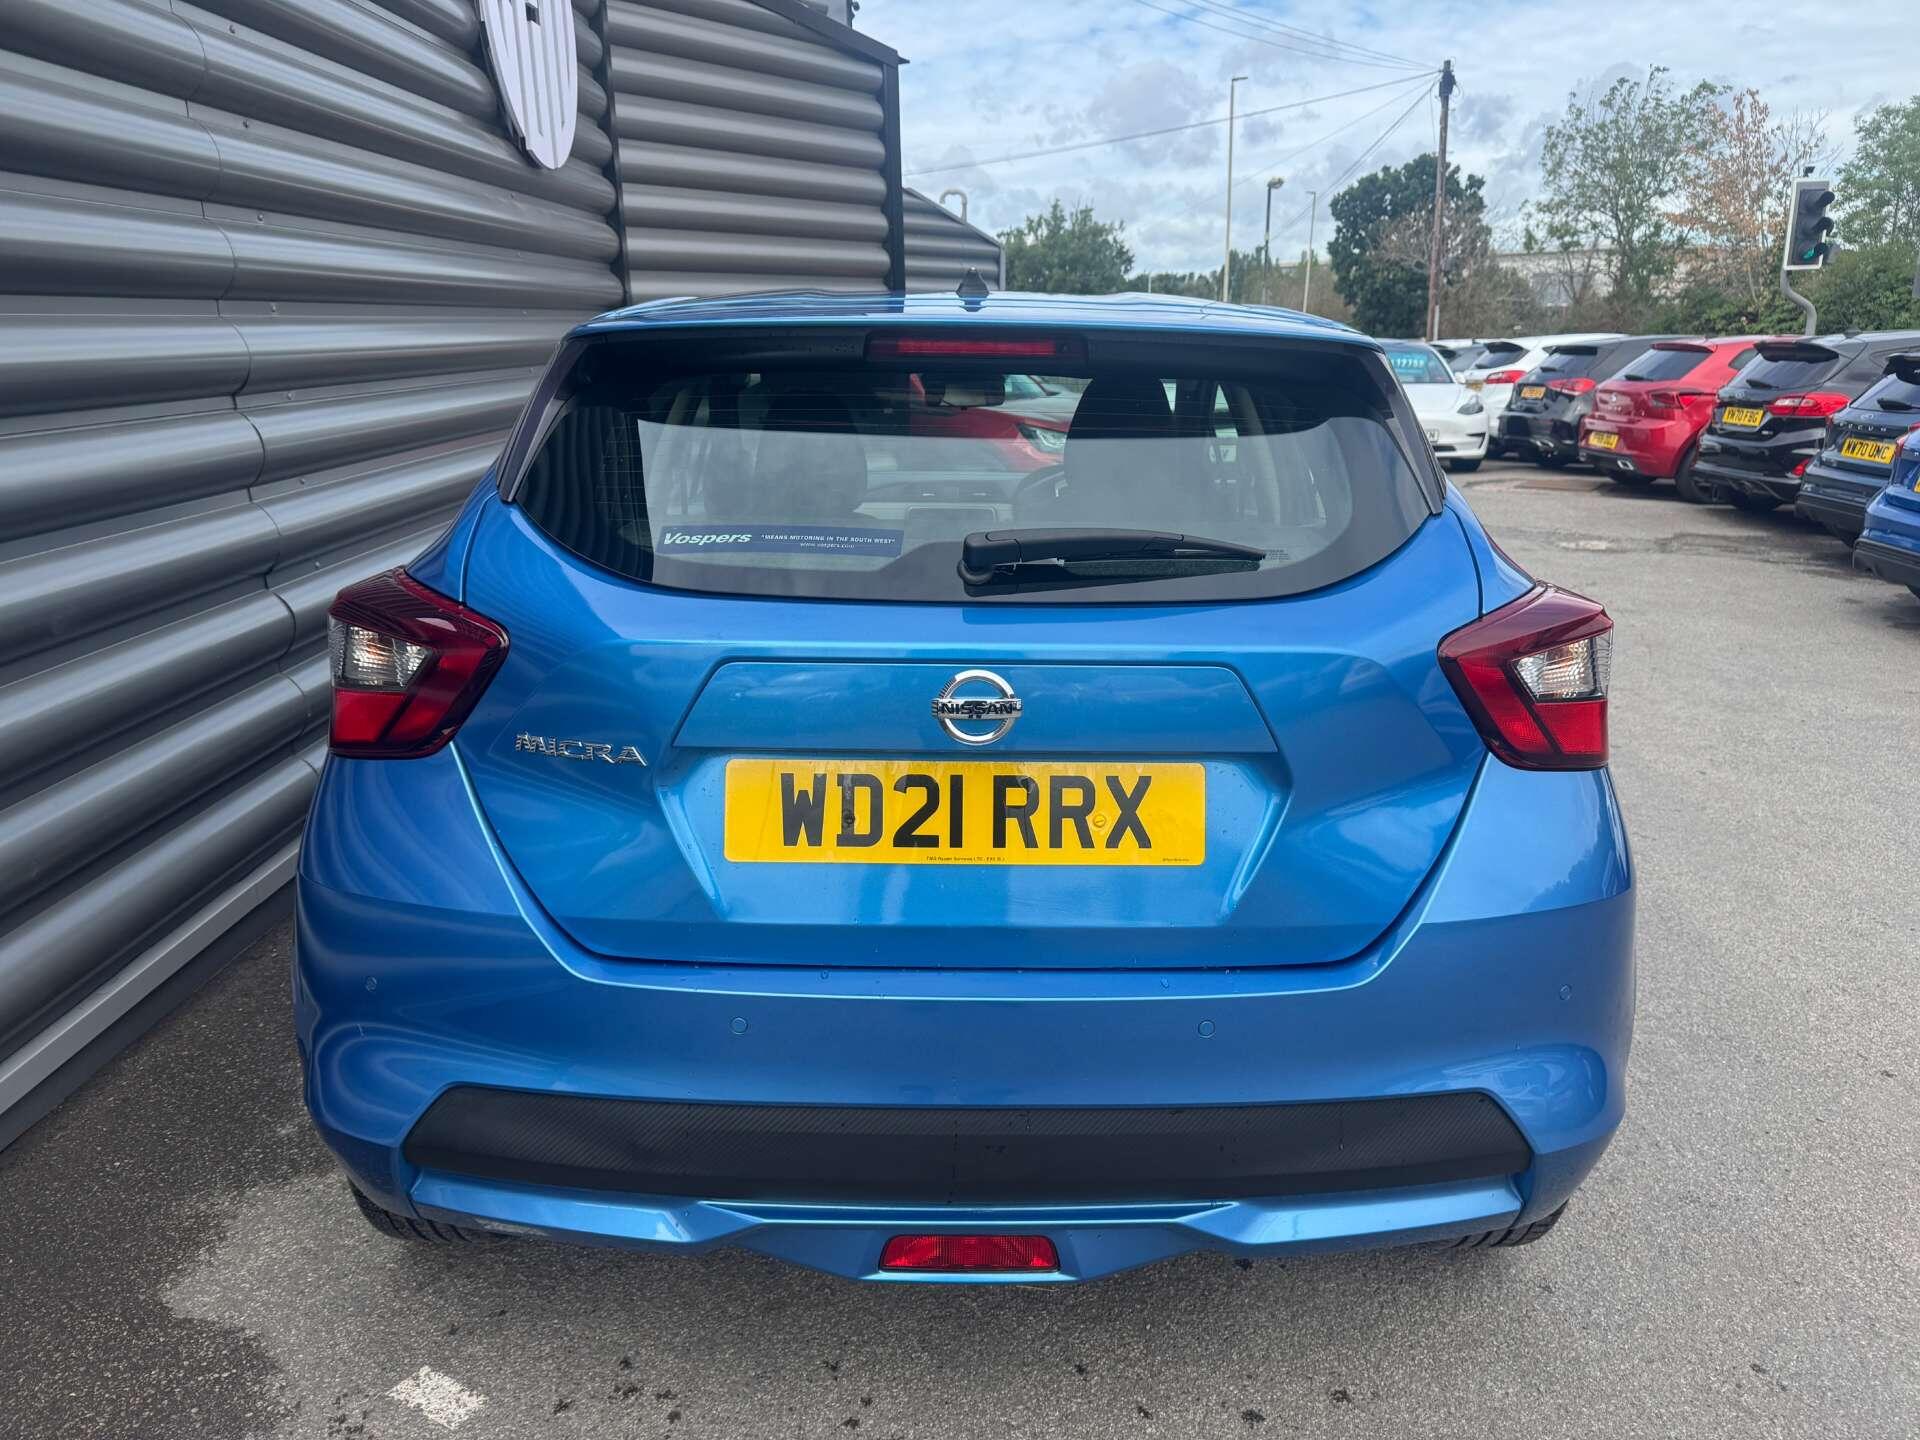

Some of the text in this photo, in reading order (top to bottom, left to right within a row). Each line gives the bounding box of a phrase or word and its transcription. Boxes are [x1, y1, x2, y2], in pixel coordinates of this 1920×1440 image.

[664, 532, 752, 546] Vospers
[940, 702, 1013, 715] NISSAN
[515, 731, 648, 767] MICRA
[780, 773, 1152, 849] WD21 RRX
